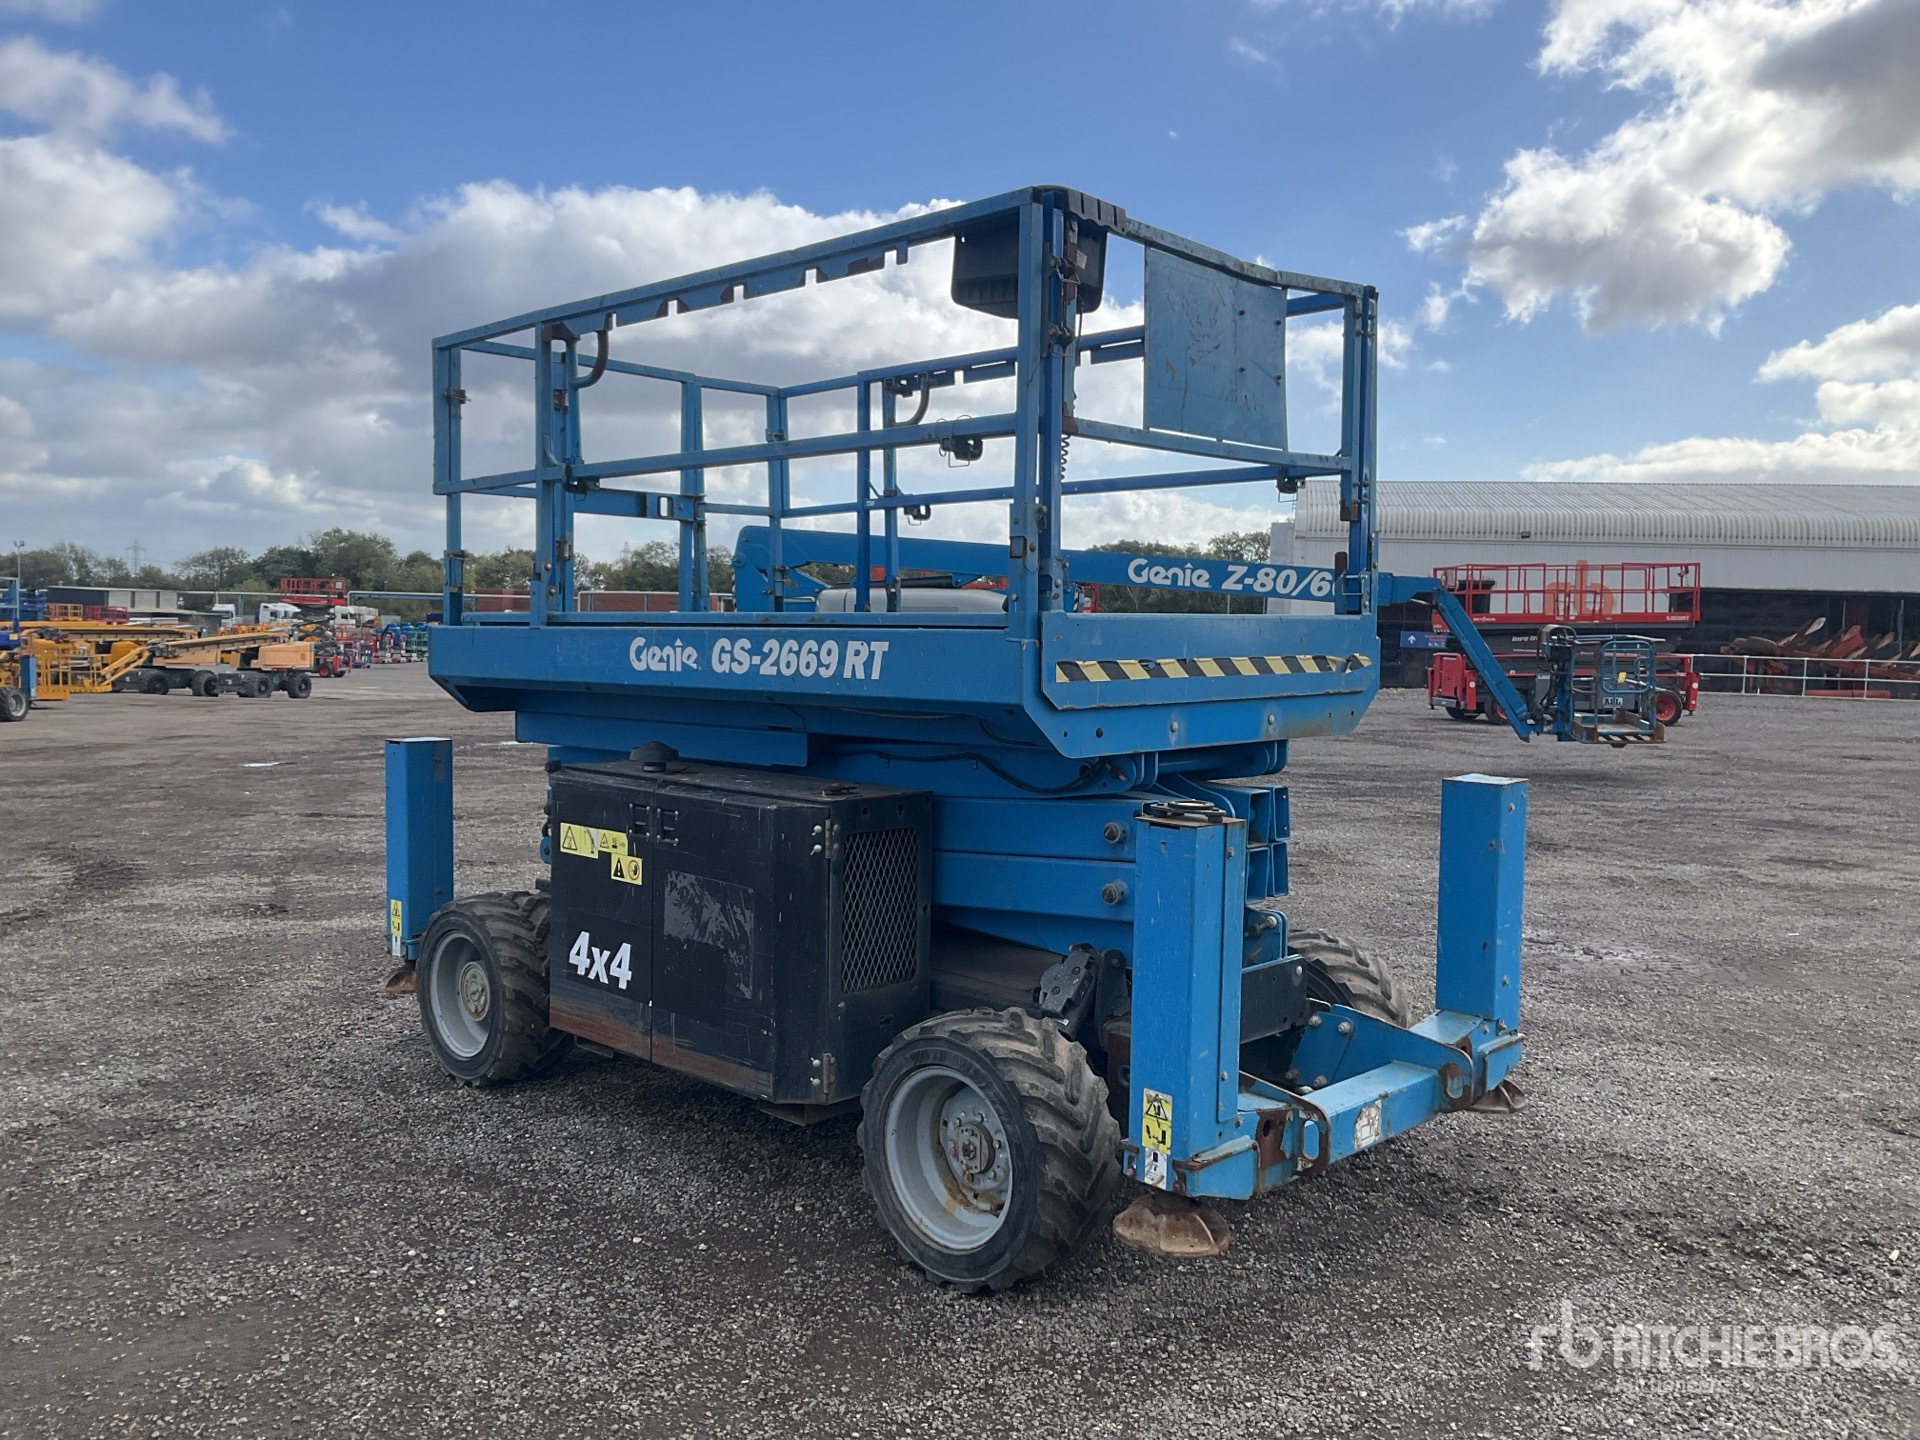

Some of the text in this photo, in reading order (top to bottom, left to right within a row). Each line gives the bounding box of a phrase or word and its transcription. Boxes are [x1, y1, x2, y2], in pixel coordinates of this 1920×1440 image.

[1127, 557, 1335, 597] Genie Z-80/6
[629, 636, 889, 680] Genie GS-2669 RT
[568, 930, 632, 990] 4x4
